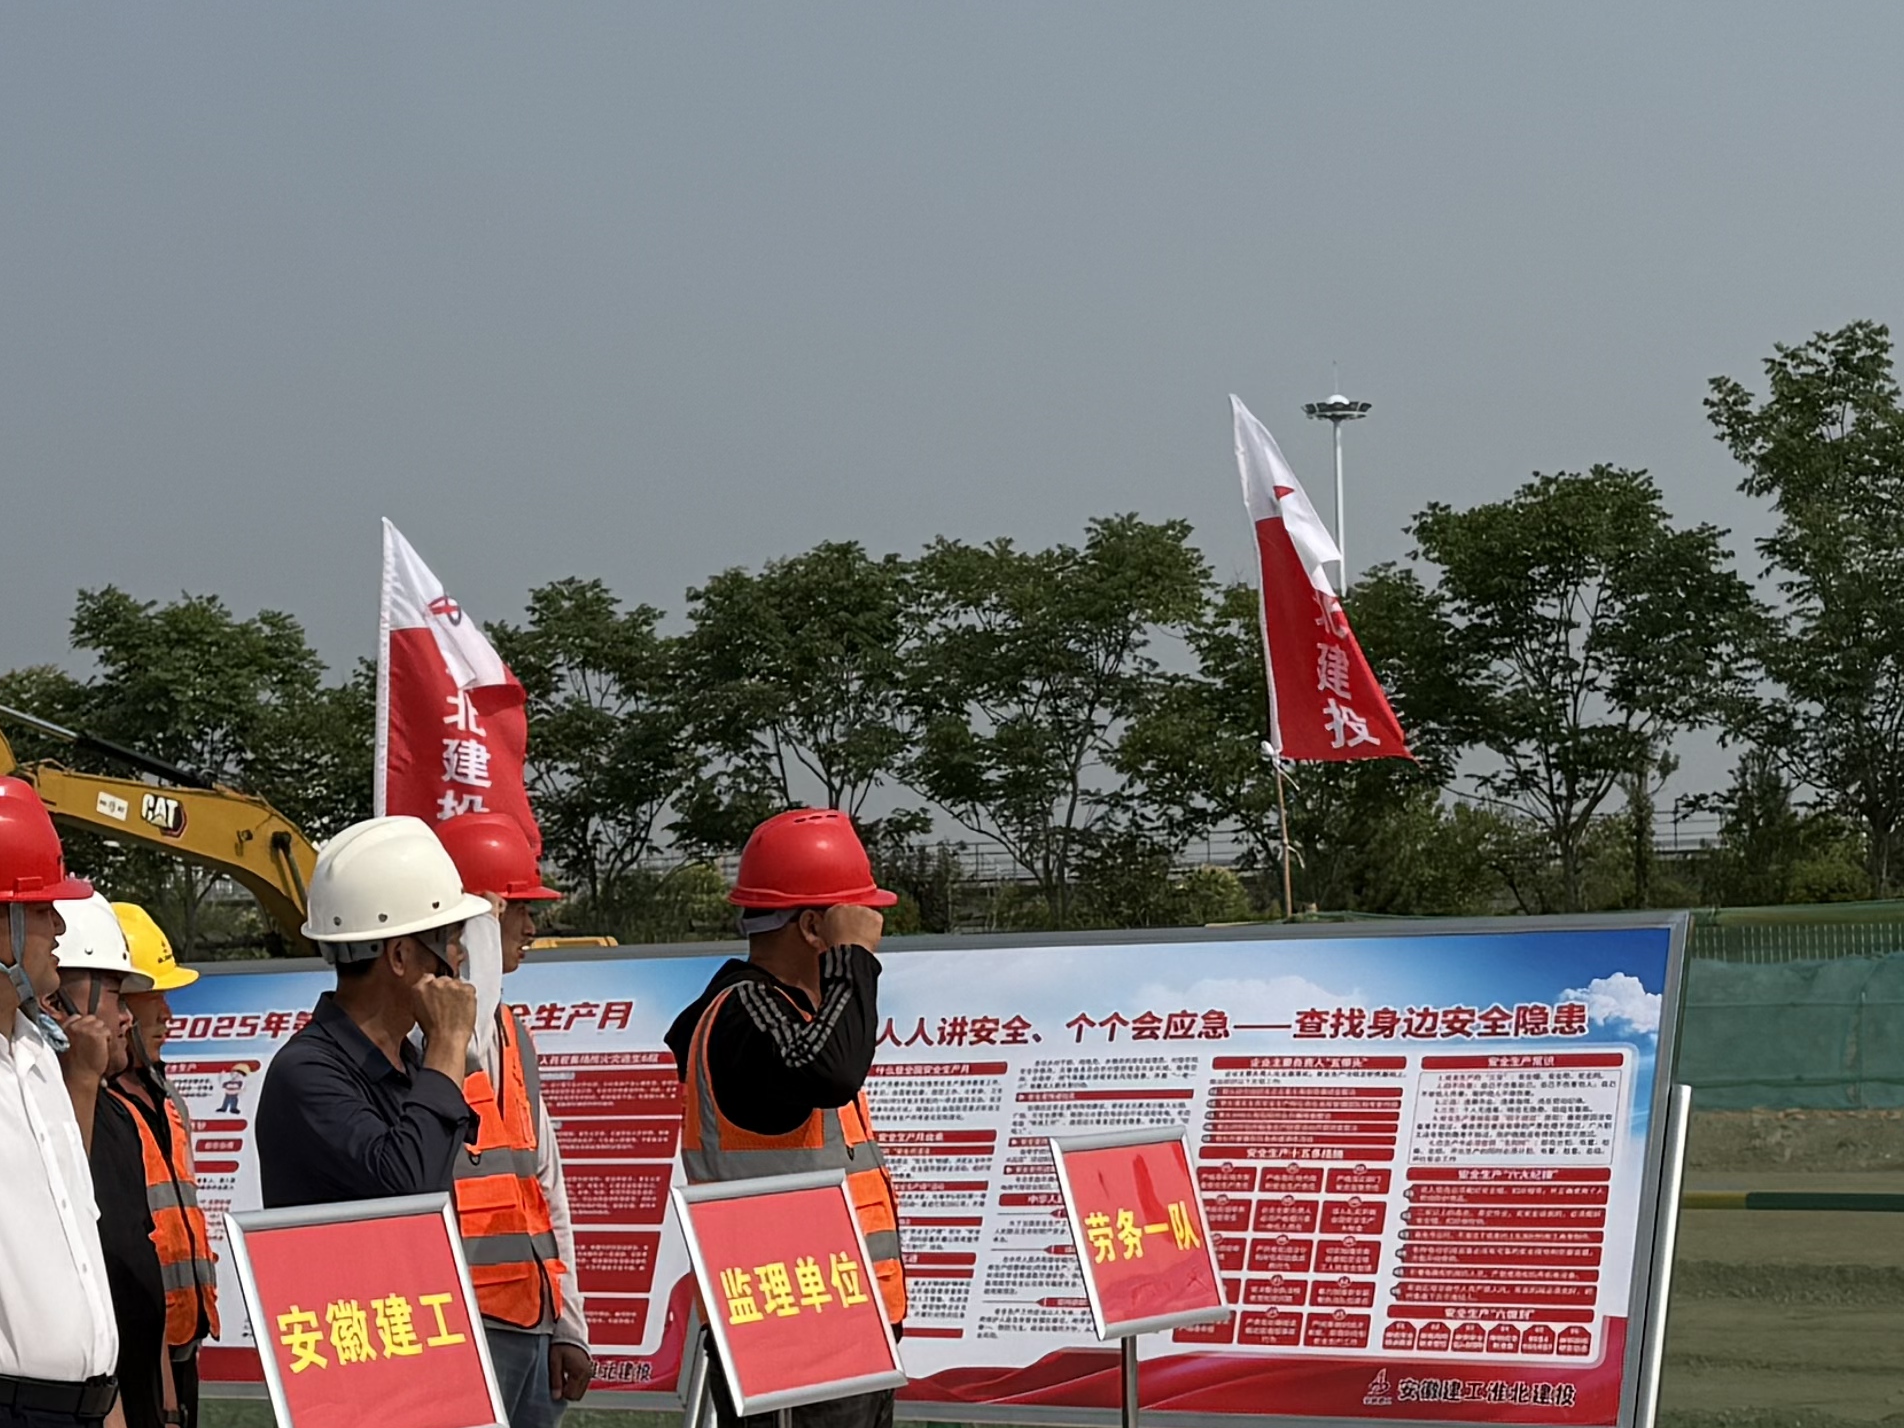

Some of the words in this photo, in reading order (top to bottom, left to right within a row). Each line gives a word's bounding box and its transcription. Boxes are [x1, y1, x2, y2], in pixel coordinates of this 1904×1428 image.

[142, 793, 179, 828] CAT
[1085, 1201, 1200, 1264] 劳务一队
[720, 1251, 869, 1325] 监理单位
[276, 1292, 466, 1374] 安徽建工
[1398, 1378, 1576, 1406] 安徽建工淮北建投
